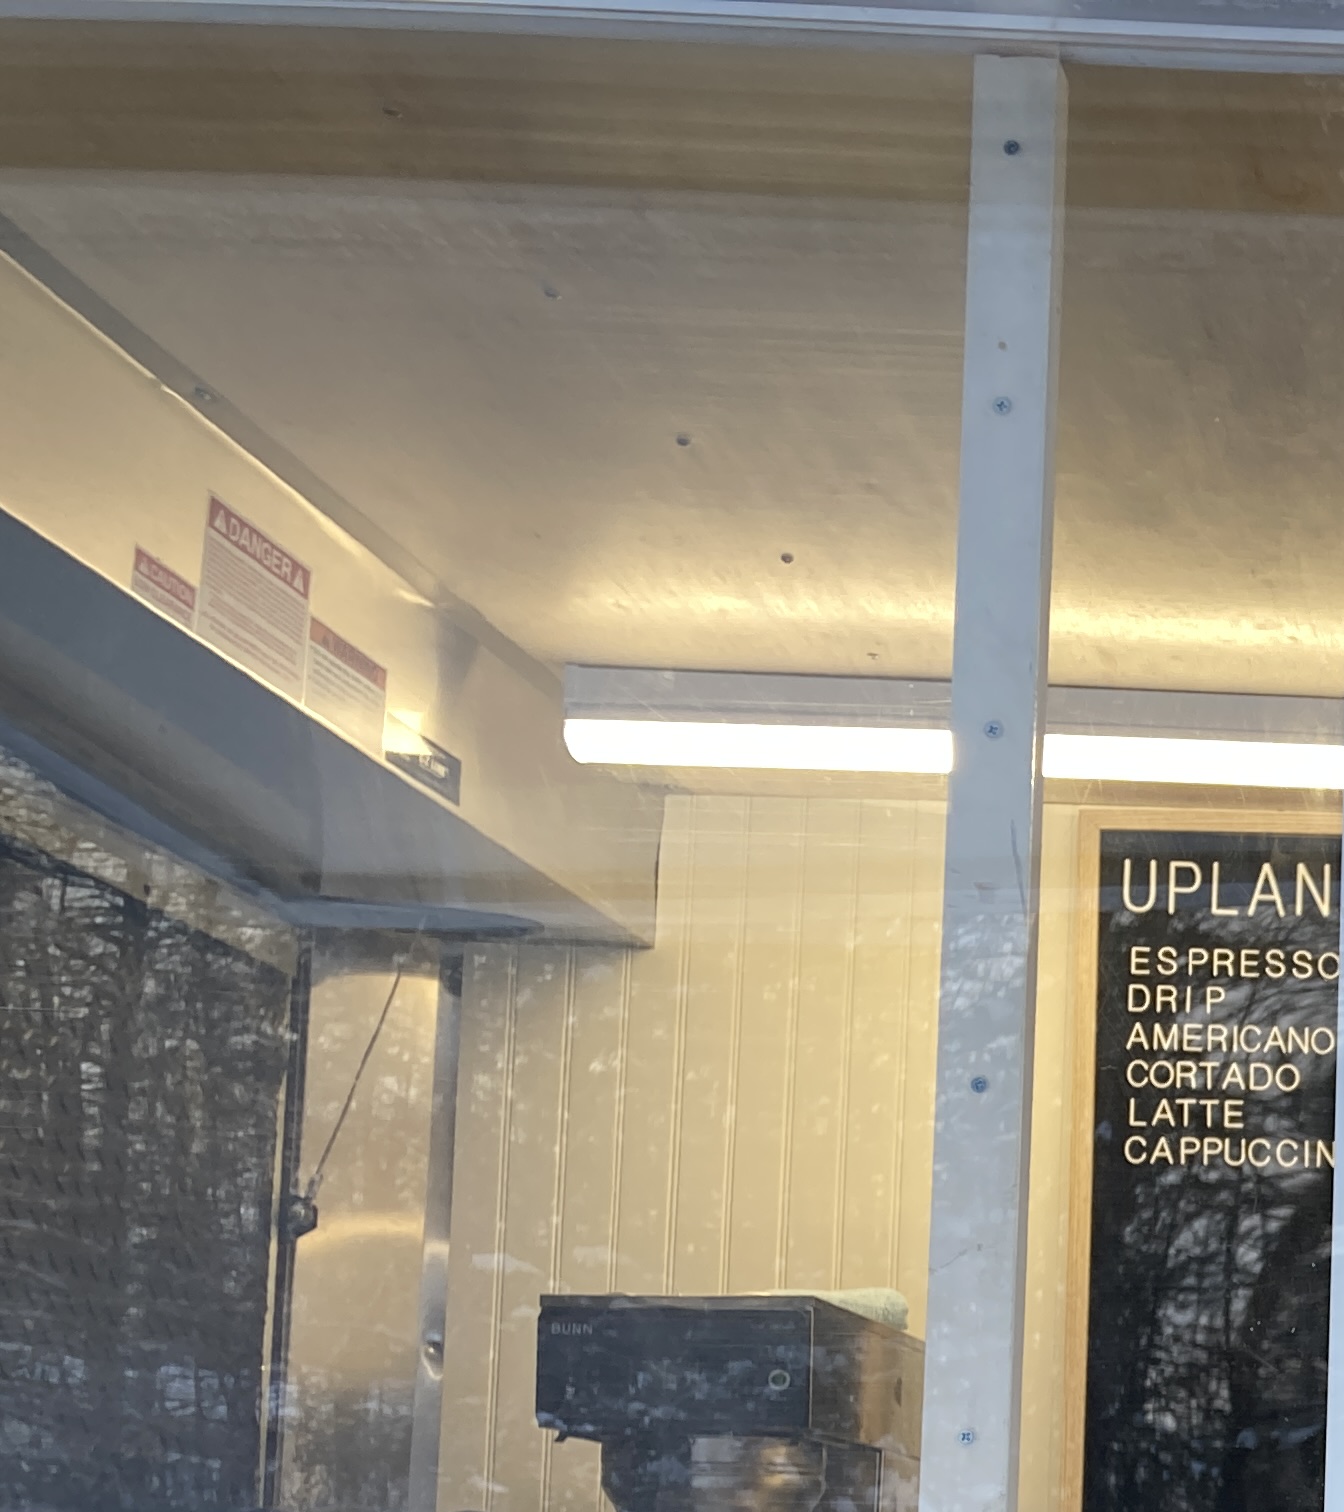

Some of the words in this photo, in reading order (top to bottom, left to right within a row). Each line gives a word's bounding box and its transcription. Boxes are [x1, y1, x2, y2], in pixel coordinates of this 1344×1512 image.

[228, 517, 293, 582] DANGER
[1121, 858, 1333, 918] UPLAN
[1129, 946, 1341, 980] ESPRESSO
[1126, 984, 1227, 1014] DRIP
[1125, 1023, 1335, 1056] AMERICANO
[1125, 1060, 1301, 1092] CORTADO
[1128, 1098, 1245, 1129] LATTE
[1123, 1137, 1336, 1169] CAPPUCCIN
[551, 1322, 593, 1335] BUNN
